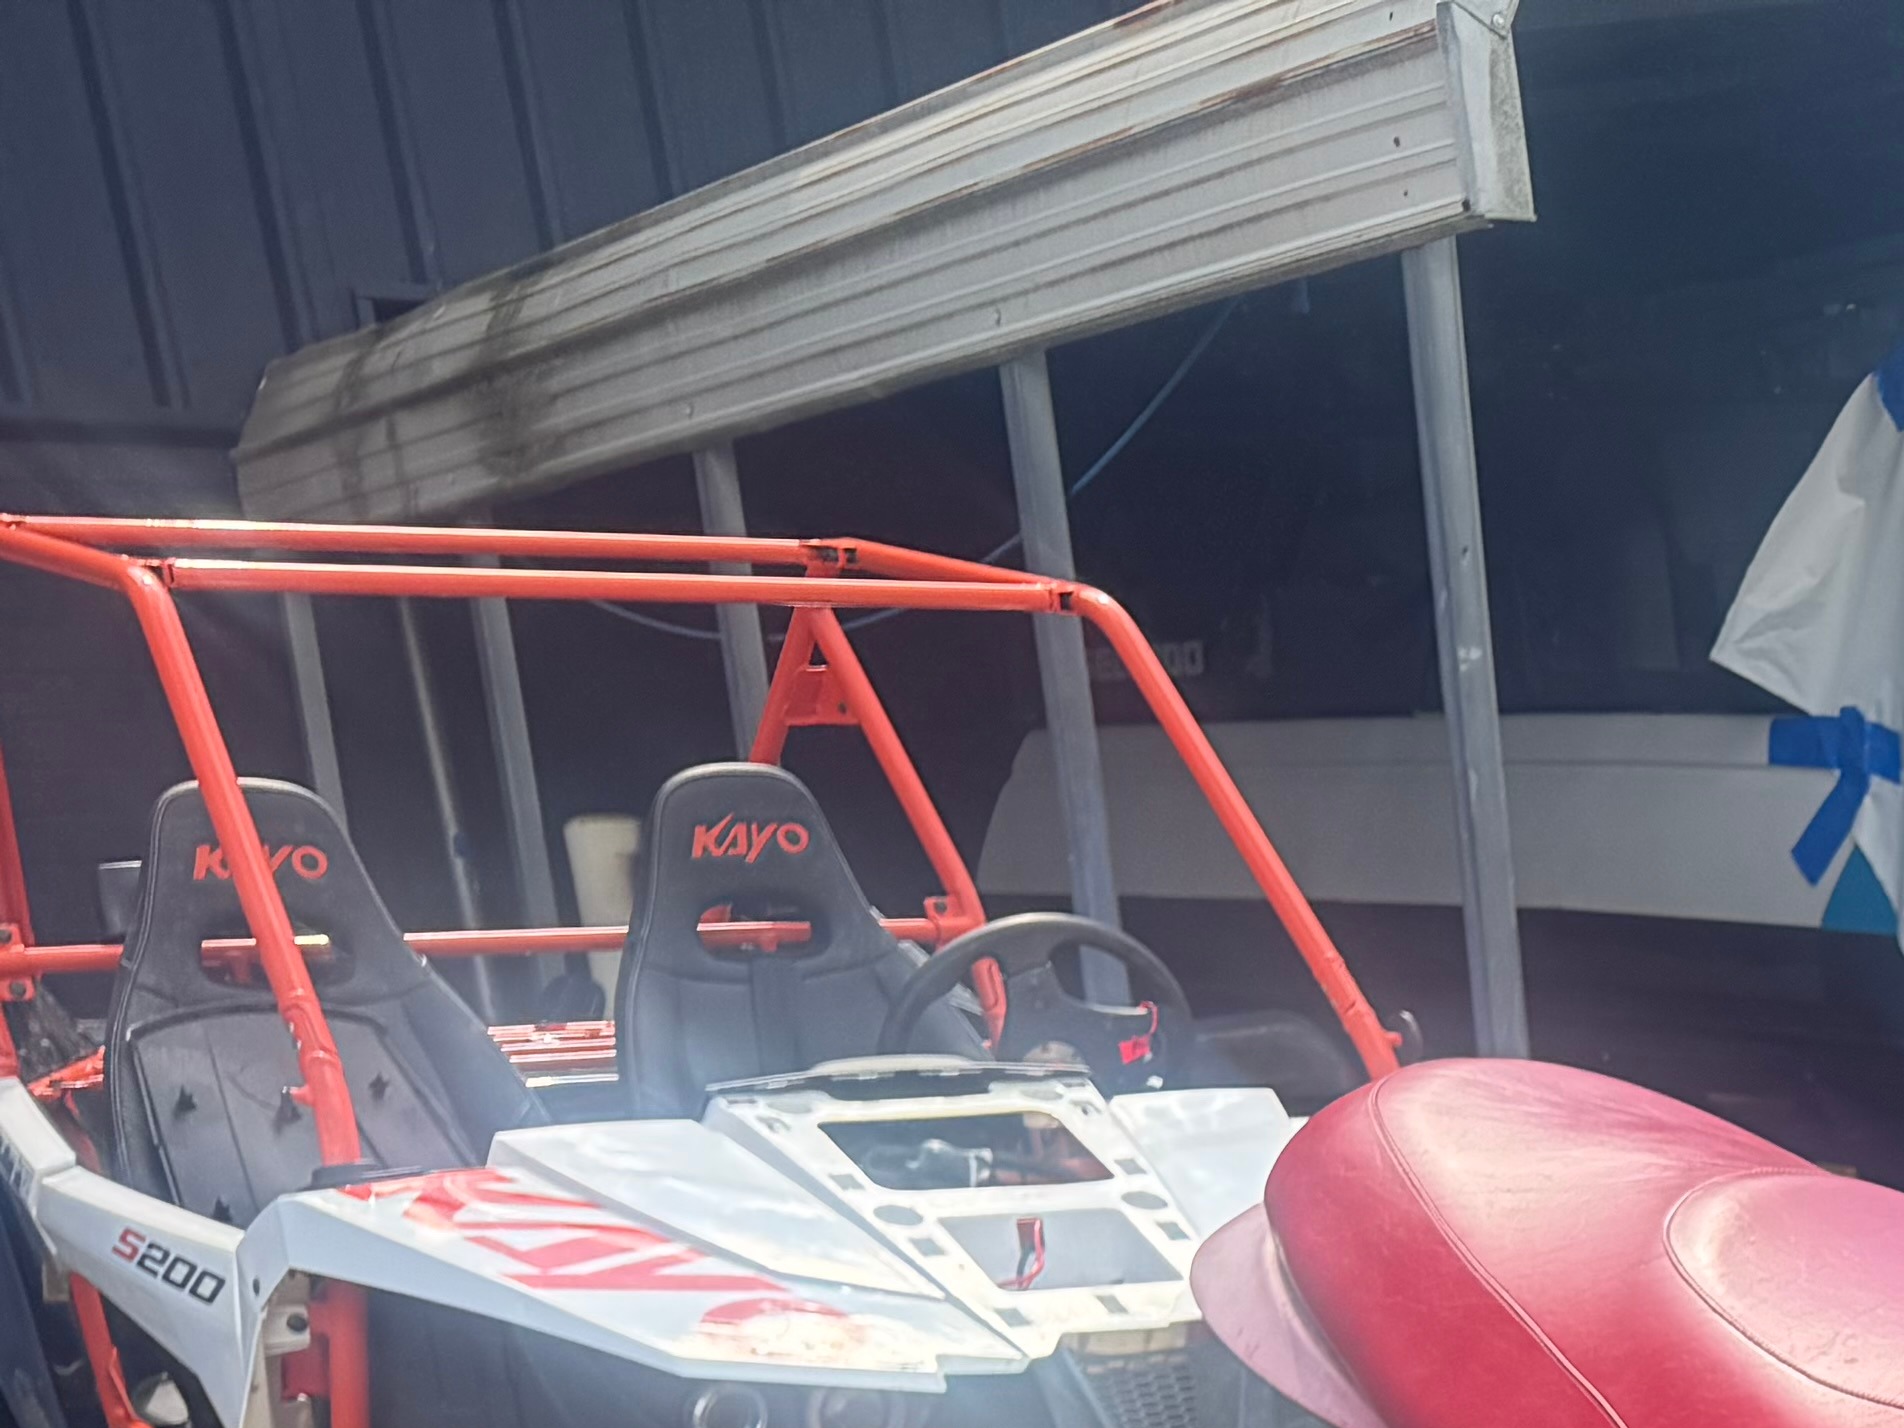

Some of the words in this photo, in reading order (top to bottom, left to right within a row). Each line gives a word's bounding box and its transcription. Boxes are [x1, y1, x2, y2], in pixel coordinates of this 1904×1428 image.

[192, 843, 329, 881] KYO
[691, 811, 810, 864] KAYO
[111, 1225, 227, 1305] S200
